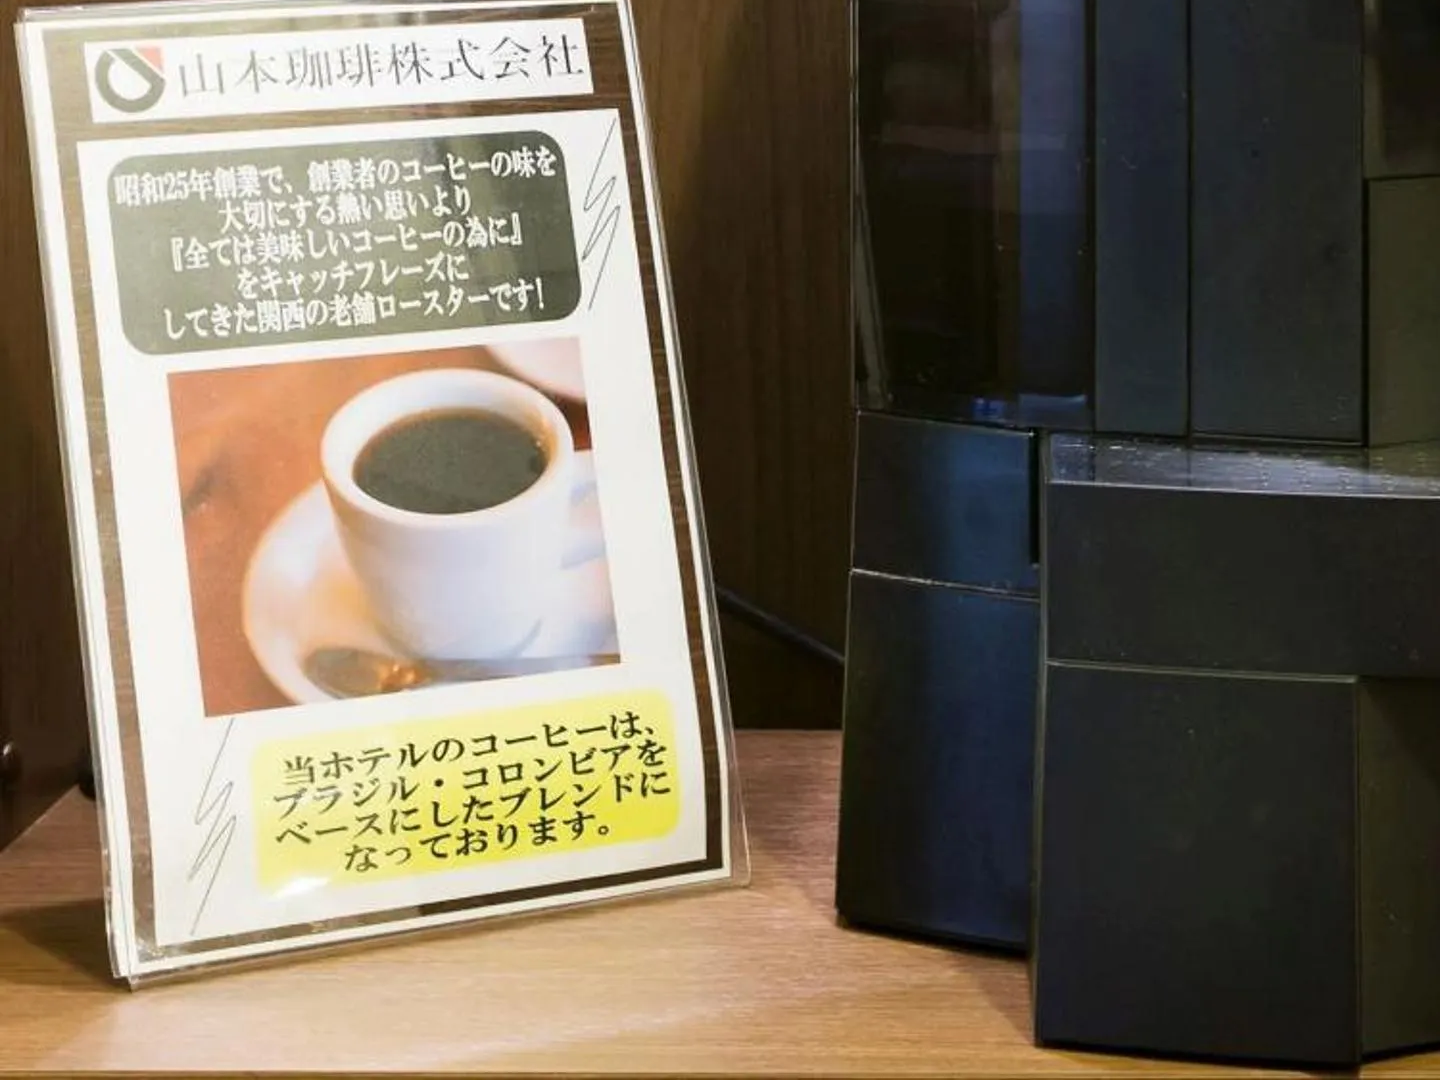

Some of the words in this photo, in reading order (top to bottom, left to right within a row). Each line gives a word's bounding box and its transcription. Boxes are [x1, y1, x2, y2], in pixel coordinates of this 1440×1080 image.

[178, 32, 585, 98] 山本珈琲株式会社
[237, 252, 469, 299] をキャッチフレーズに
[273, 738, 667, 820] ブラジル・コロンビアを
[282, 711, 656, 785] 当ホテルのコーヒーは、
[275, 769, 672, 846] ベースにしたブレンドに
[344, 811, 613, 872] なっております。
